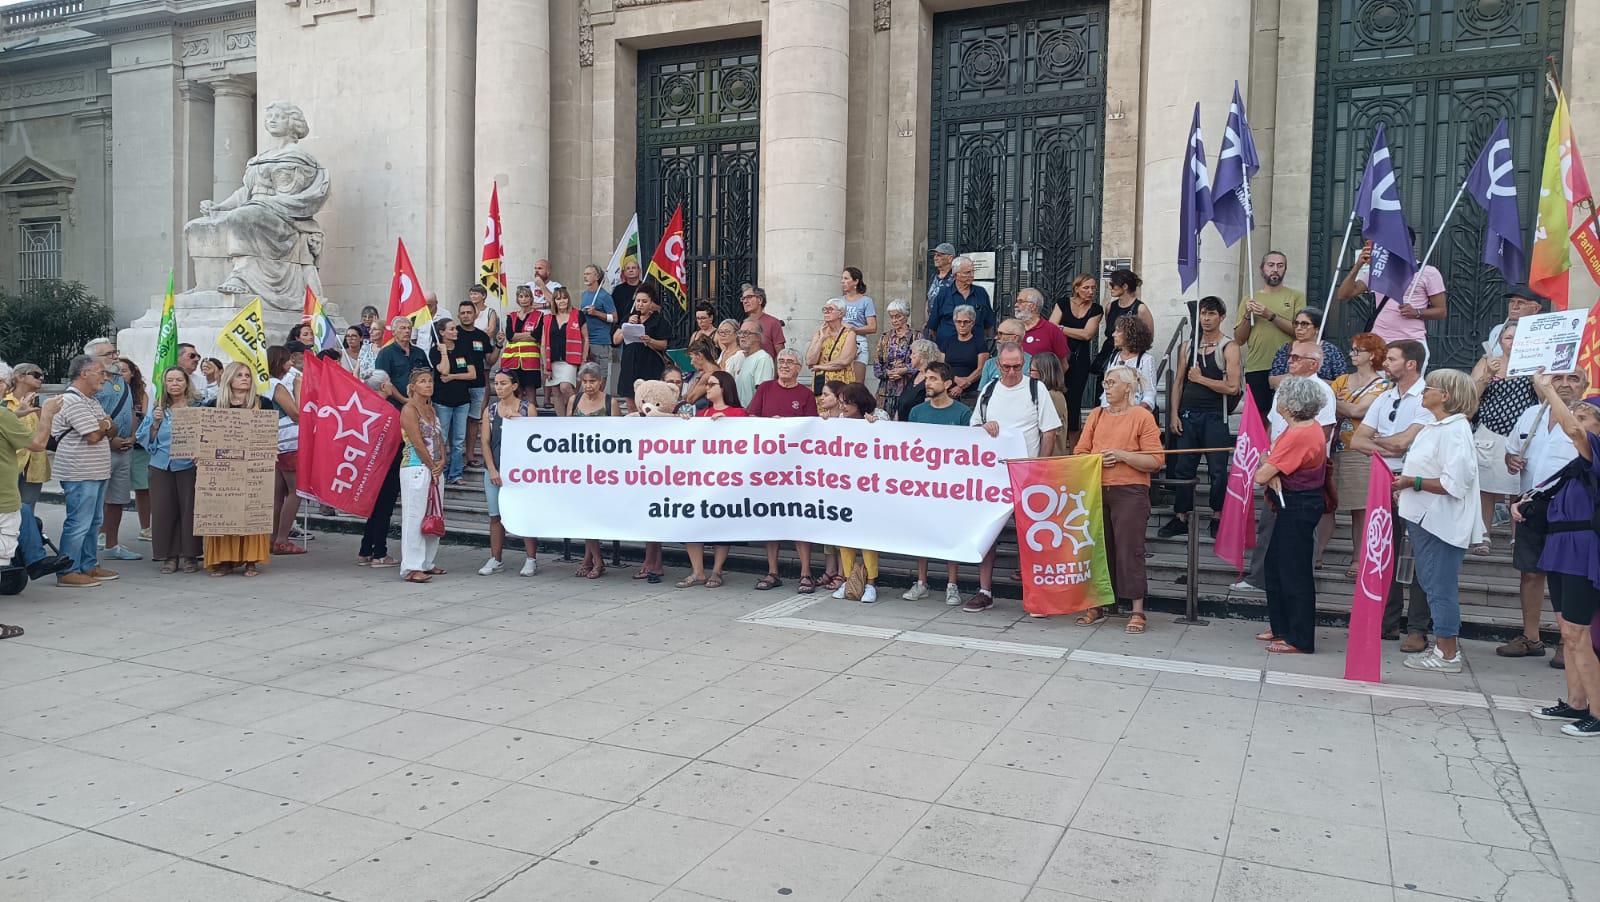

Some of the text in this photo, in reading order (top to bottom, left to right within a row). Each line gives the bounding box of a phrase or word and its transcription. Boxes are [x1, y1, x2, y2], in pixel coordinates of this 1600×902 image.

[1577, 231, 1595, 256] Parti
[657, 269, 687, 303] VAR
[1529, 321, 1560, 332] STOP
[526, 433, 997, 471] Coalition pour une loi-cadre intégrale
[508, 464, 1014, 504] contre les violences sexistes et sexuelles
[648, 497, 854, 522] aire toulonnaise
[1032, 560, 1092, 574] PARTIT
[1033, 570, 1092, 585] OCCITAN
